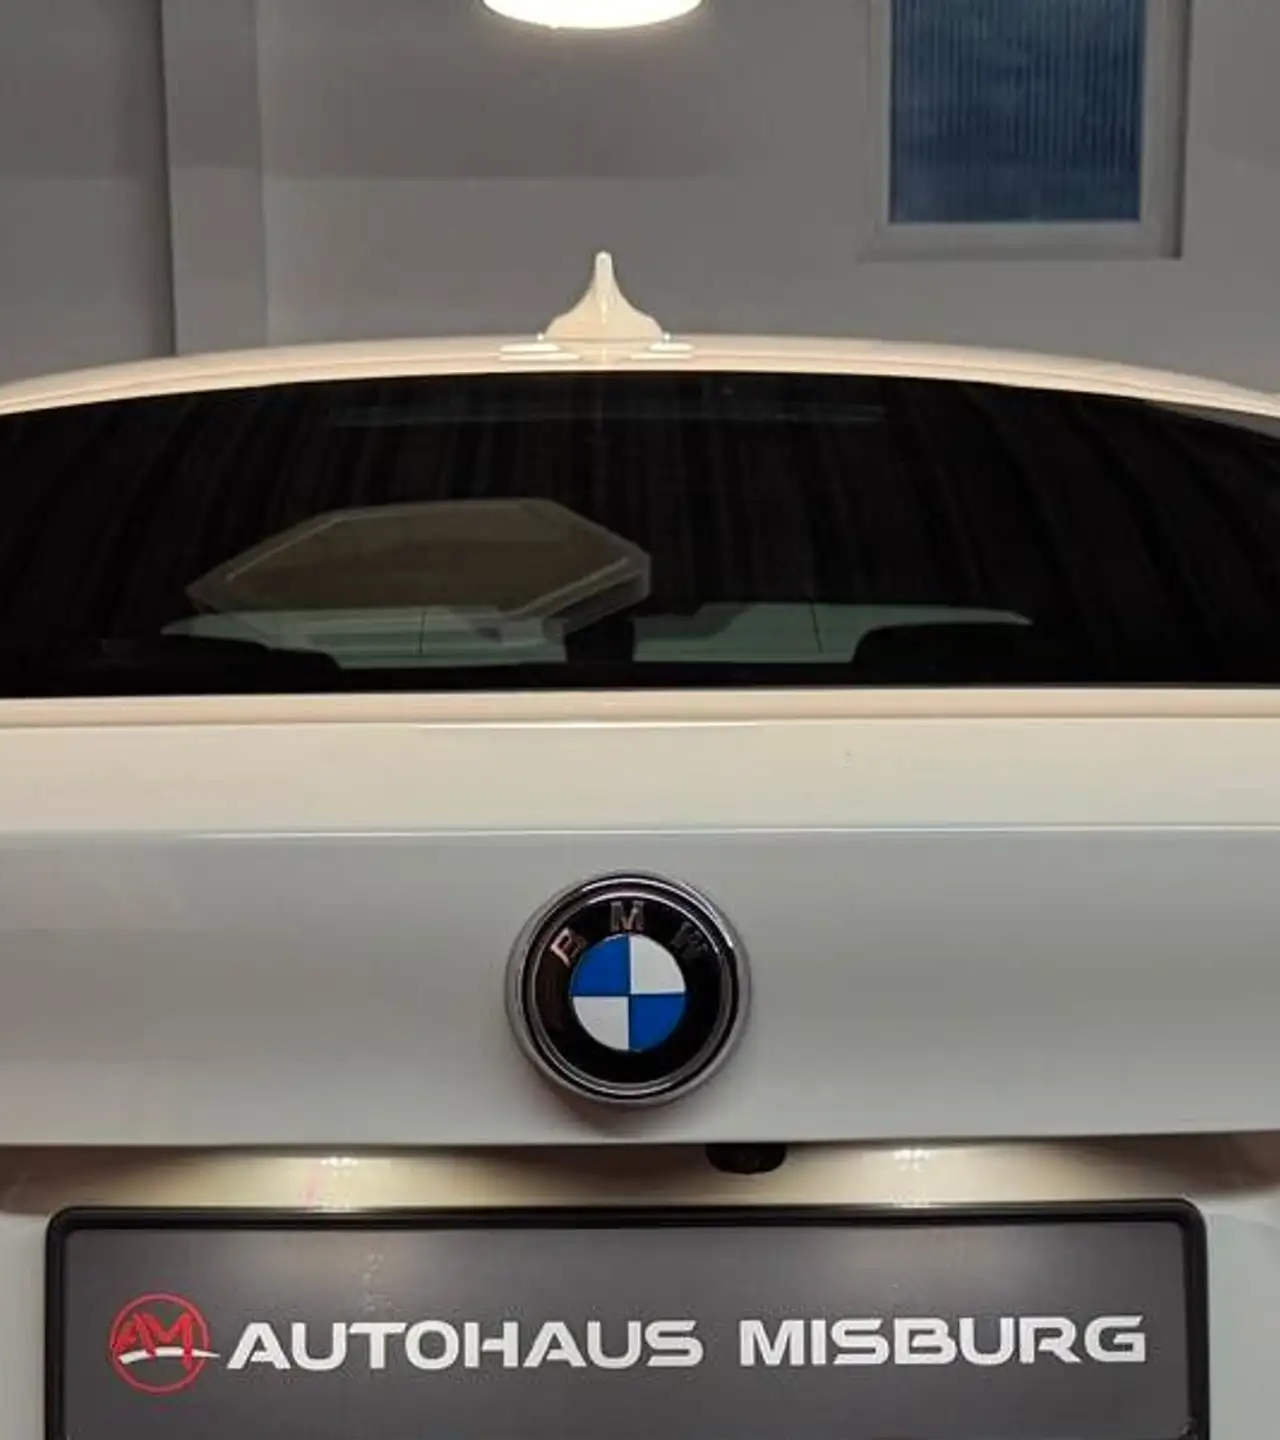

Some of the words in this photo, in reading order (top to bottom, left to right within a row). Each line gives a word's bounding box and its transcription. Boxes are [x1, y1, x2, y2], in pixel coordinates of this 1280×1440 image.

[550, 900, 710, 968] BMW
[227, 1320, 704, 1370] AUTOHAUS
[739, 1315, 1147, 1366] MISBURG
